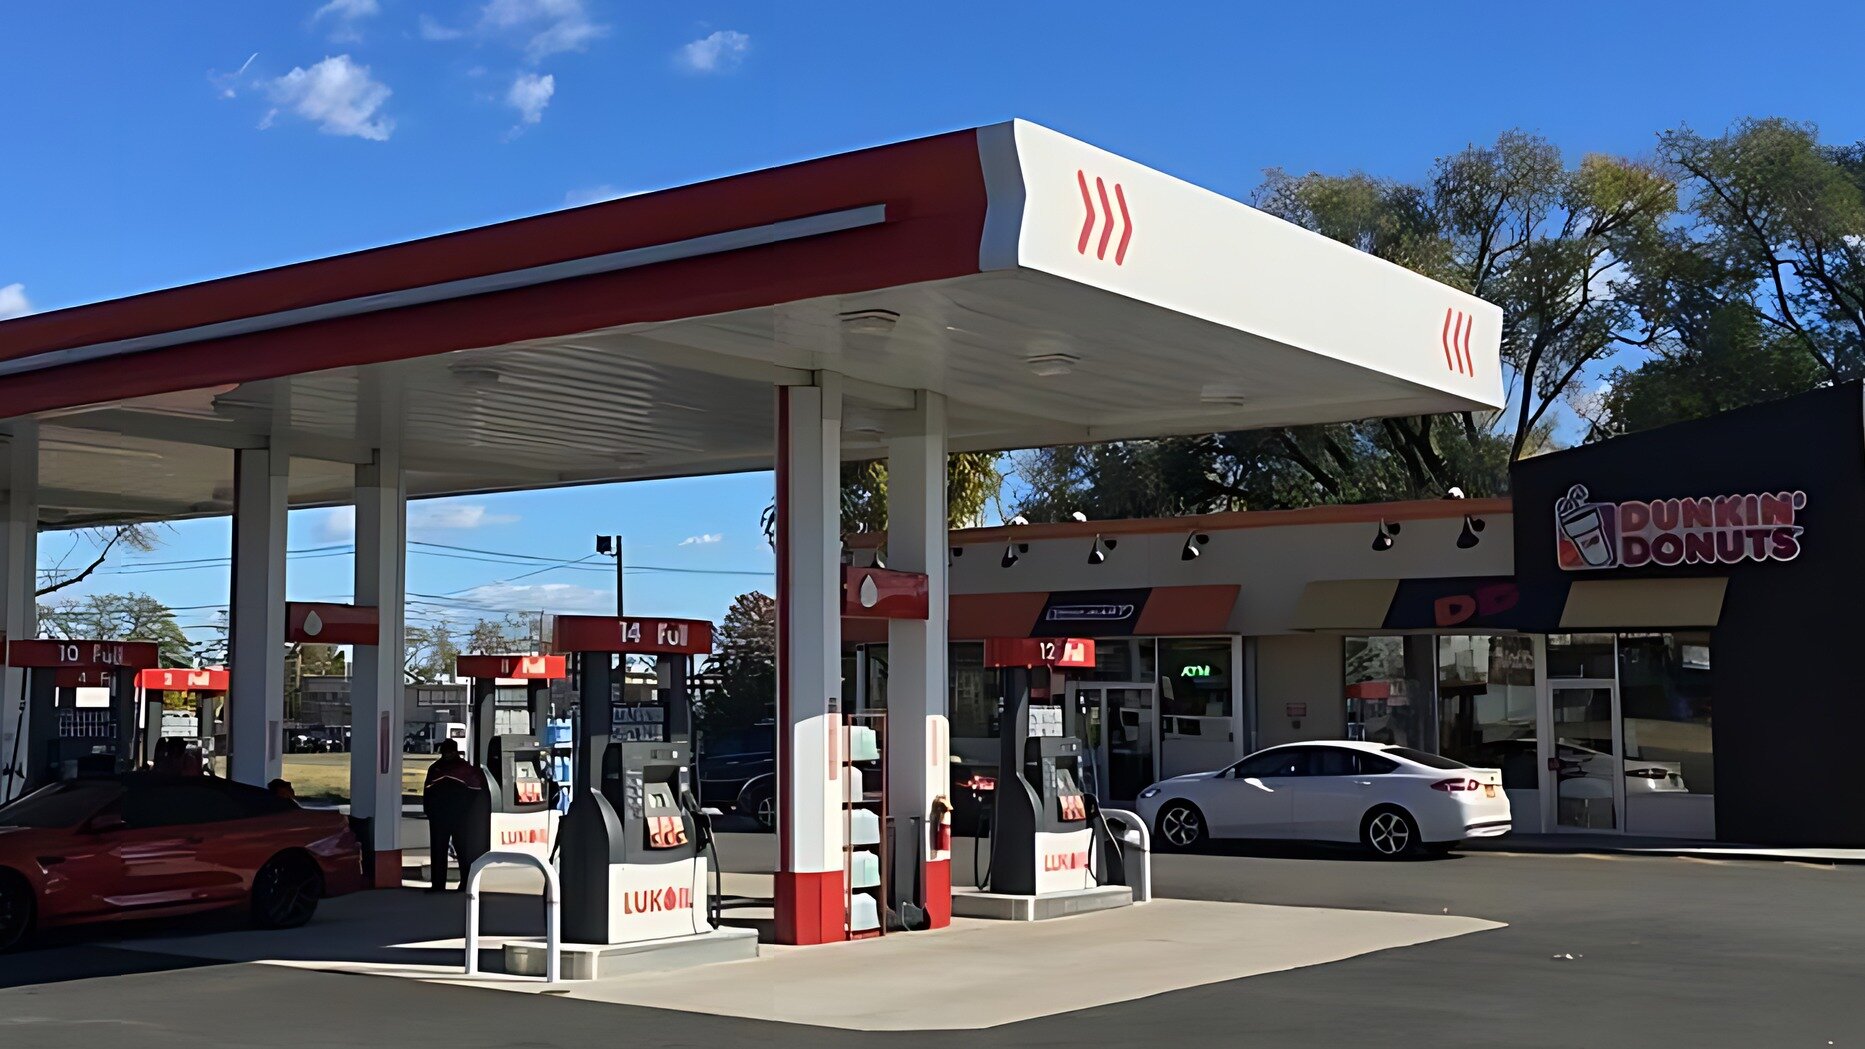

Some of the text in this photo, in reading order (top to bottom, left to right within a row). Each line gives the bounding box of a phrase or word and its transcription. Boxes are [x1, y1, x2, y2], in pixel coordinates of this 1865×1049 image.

[1620, 491, 1807, 531] DUNKIN'
[1620, 528, 1804, 566] DONUTS
[619, 621, 641, 643] 14
[59, 645, 79, 662] 10
[1040, 642, 1055, 660] 12
